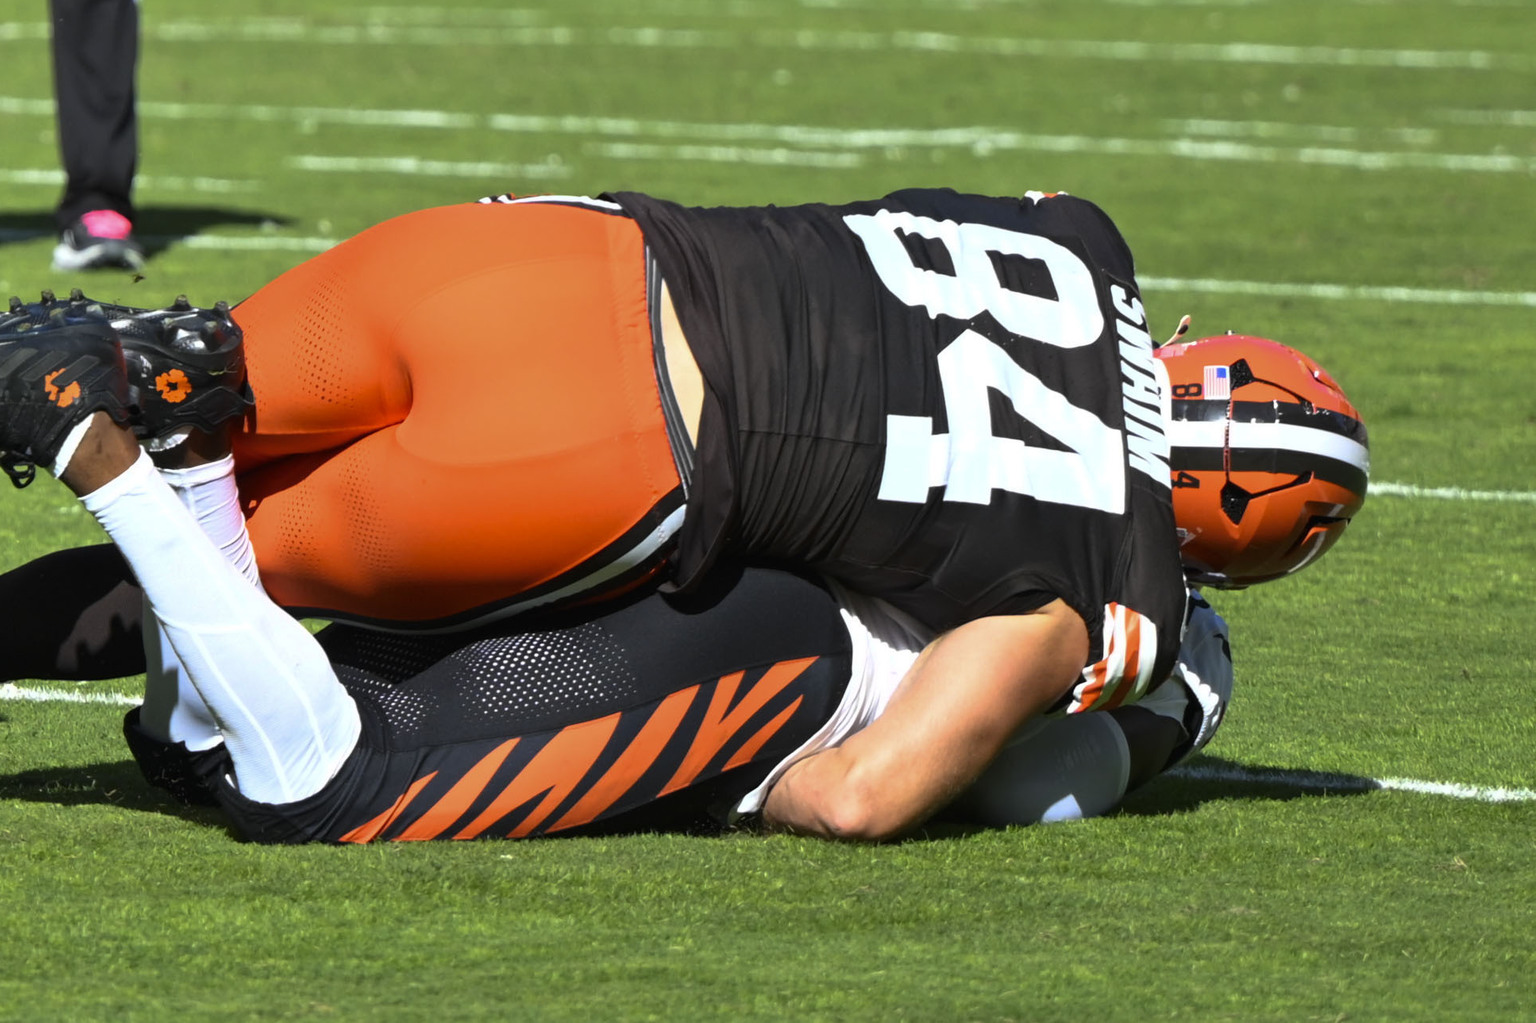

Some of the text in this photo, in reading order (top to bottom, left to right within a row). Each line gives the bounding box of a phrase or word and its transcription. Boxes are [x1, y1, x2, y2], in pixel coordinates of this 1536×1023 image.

[843, 208, 1126, 515] 84
[1110, 284, 1172, 490] SWAIM
[1172, 383, 1202, 489] 8 4
